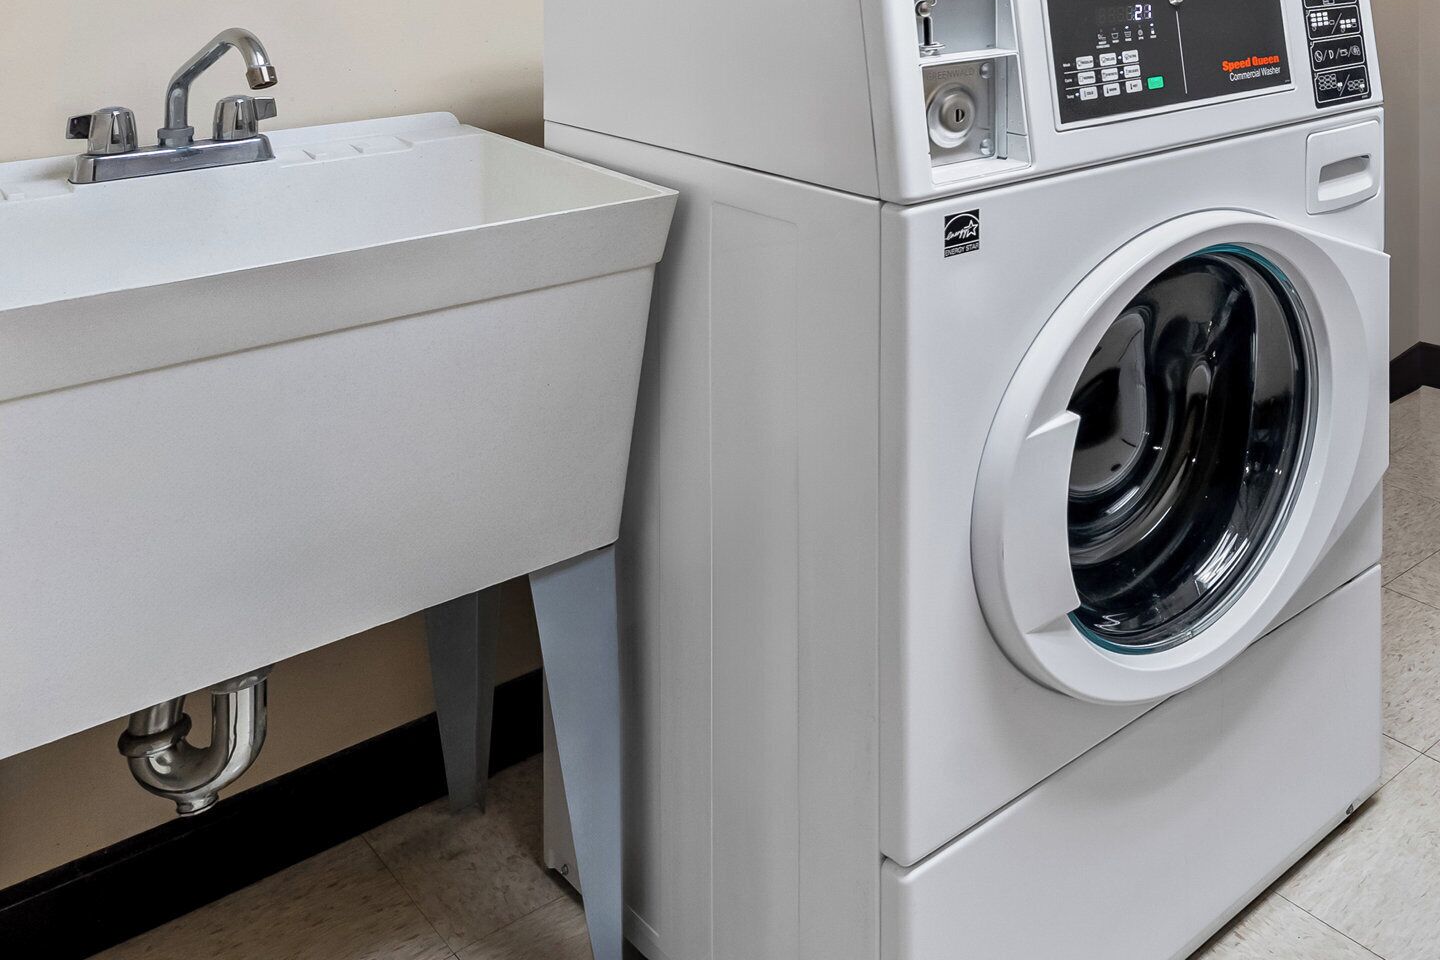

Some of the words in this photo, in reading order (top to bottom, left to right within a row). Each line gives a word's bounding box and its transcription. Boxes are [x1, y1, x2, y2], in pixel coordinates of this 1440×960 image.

[1222, 57, 1251, 72] Speed
[1252, 55, 1280, 66] Queen
[1229, 68, 1261, 81] Commercial
[1261, 66, 1281, 77] Washer
[945, 246, 965, 257] ENERGY
